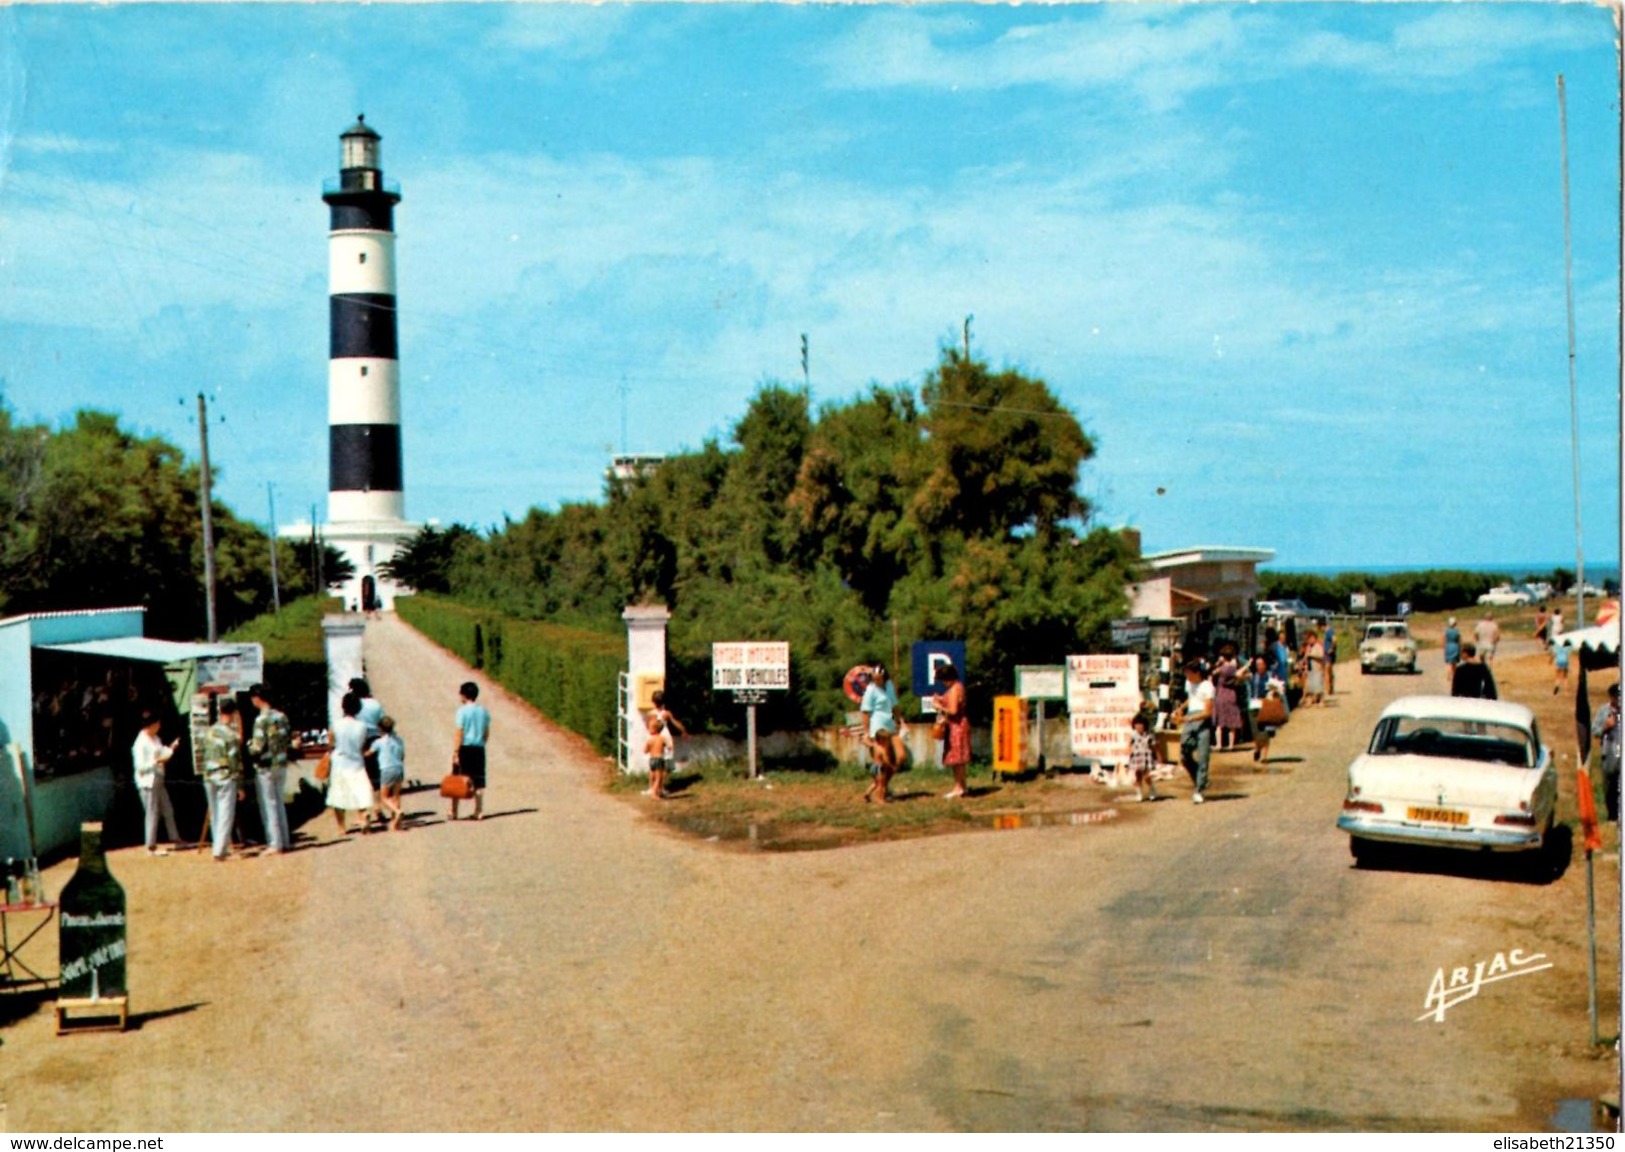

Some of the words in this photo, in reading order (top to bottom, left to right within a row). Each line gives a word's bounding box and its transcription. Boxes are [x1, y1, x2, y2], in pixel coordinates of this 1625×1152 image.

[1086, 659, 1130, 669] BOUTIQUE
[722, 667, 742, 684] TOUS
[1087, 732, 1119, 743] VENTE
